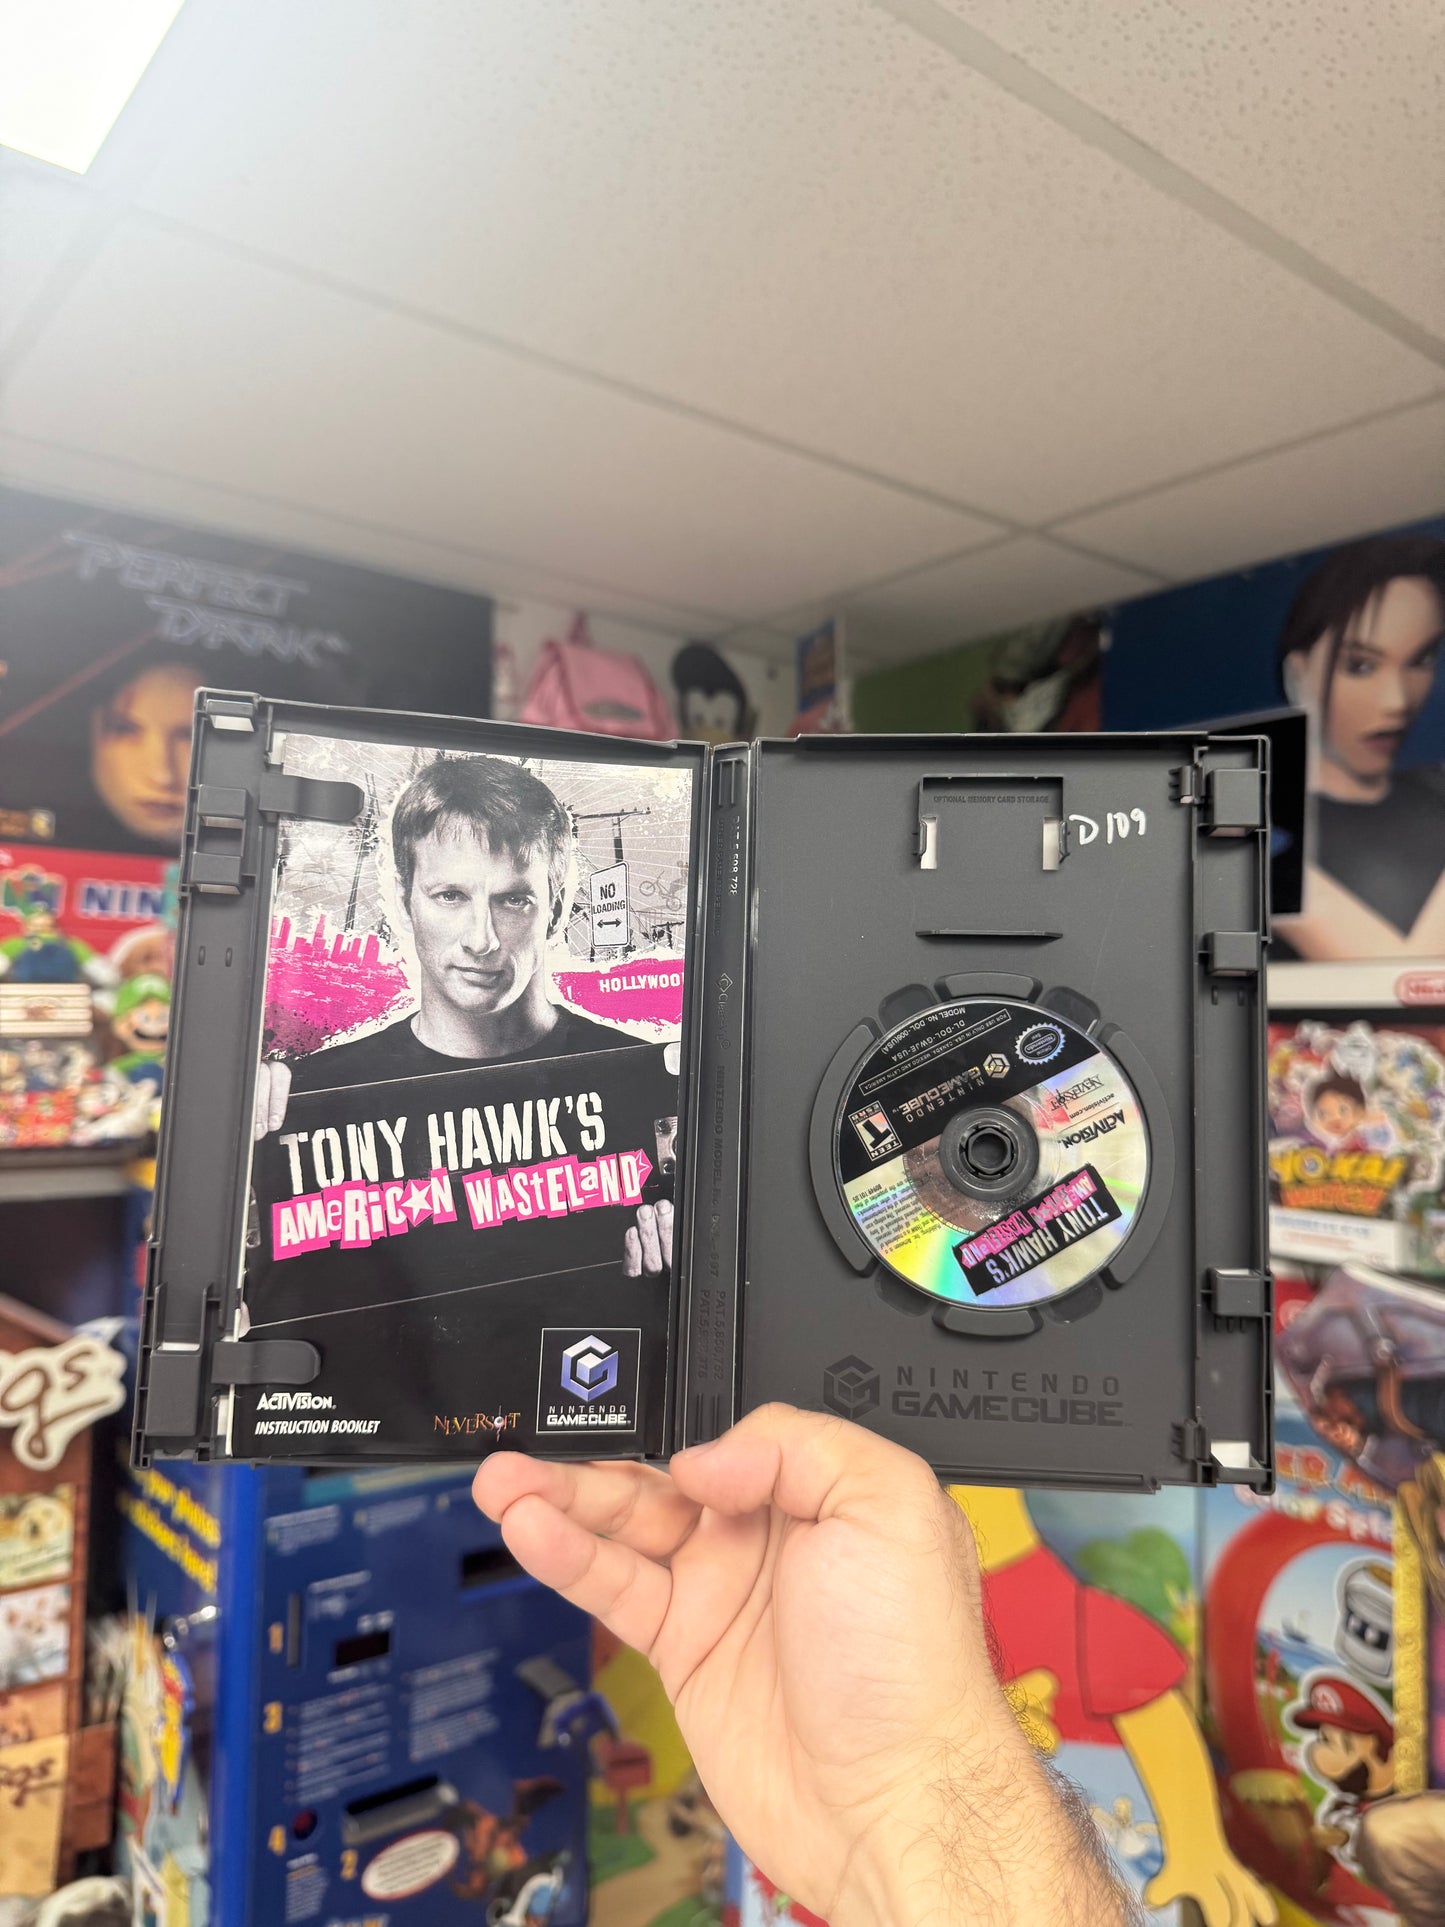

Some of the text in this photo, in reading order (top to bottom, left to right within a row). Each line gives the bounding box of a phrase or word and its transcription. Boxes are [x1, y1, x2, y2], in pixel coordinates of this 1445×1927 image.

[600, 882, 616, 899] NO
[593, 899, 626, 915] LOADING
[599, 972, 684, 993] HOLLYWOO
[1024, 1033, 1054, 1053] Nintendo
[903, 1076, 985, 1123] NINTENDO
[1068, 1092, 1115, 1120] activision.com
[280, 1092, 605, 1195] TONY HAWK'S
[869, 1139, 899, 1158] TEEN
[985, 1196, 1109, 1284] TONY HAWK'S
[893, 1364, 1121, 1396] NINTENDO
[549, 1404, 626, 1414] NINTENDO
[254, 1420, 381, 1435] INSTRUCTION BOOKLET
